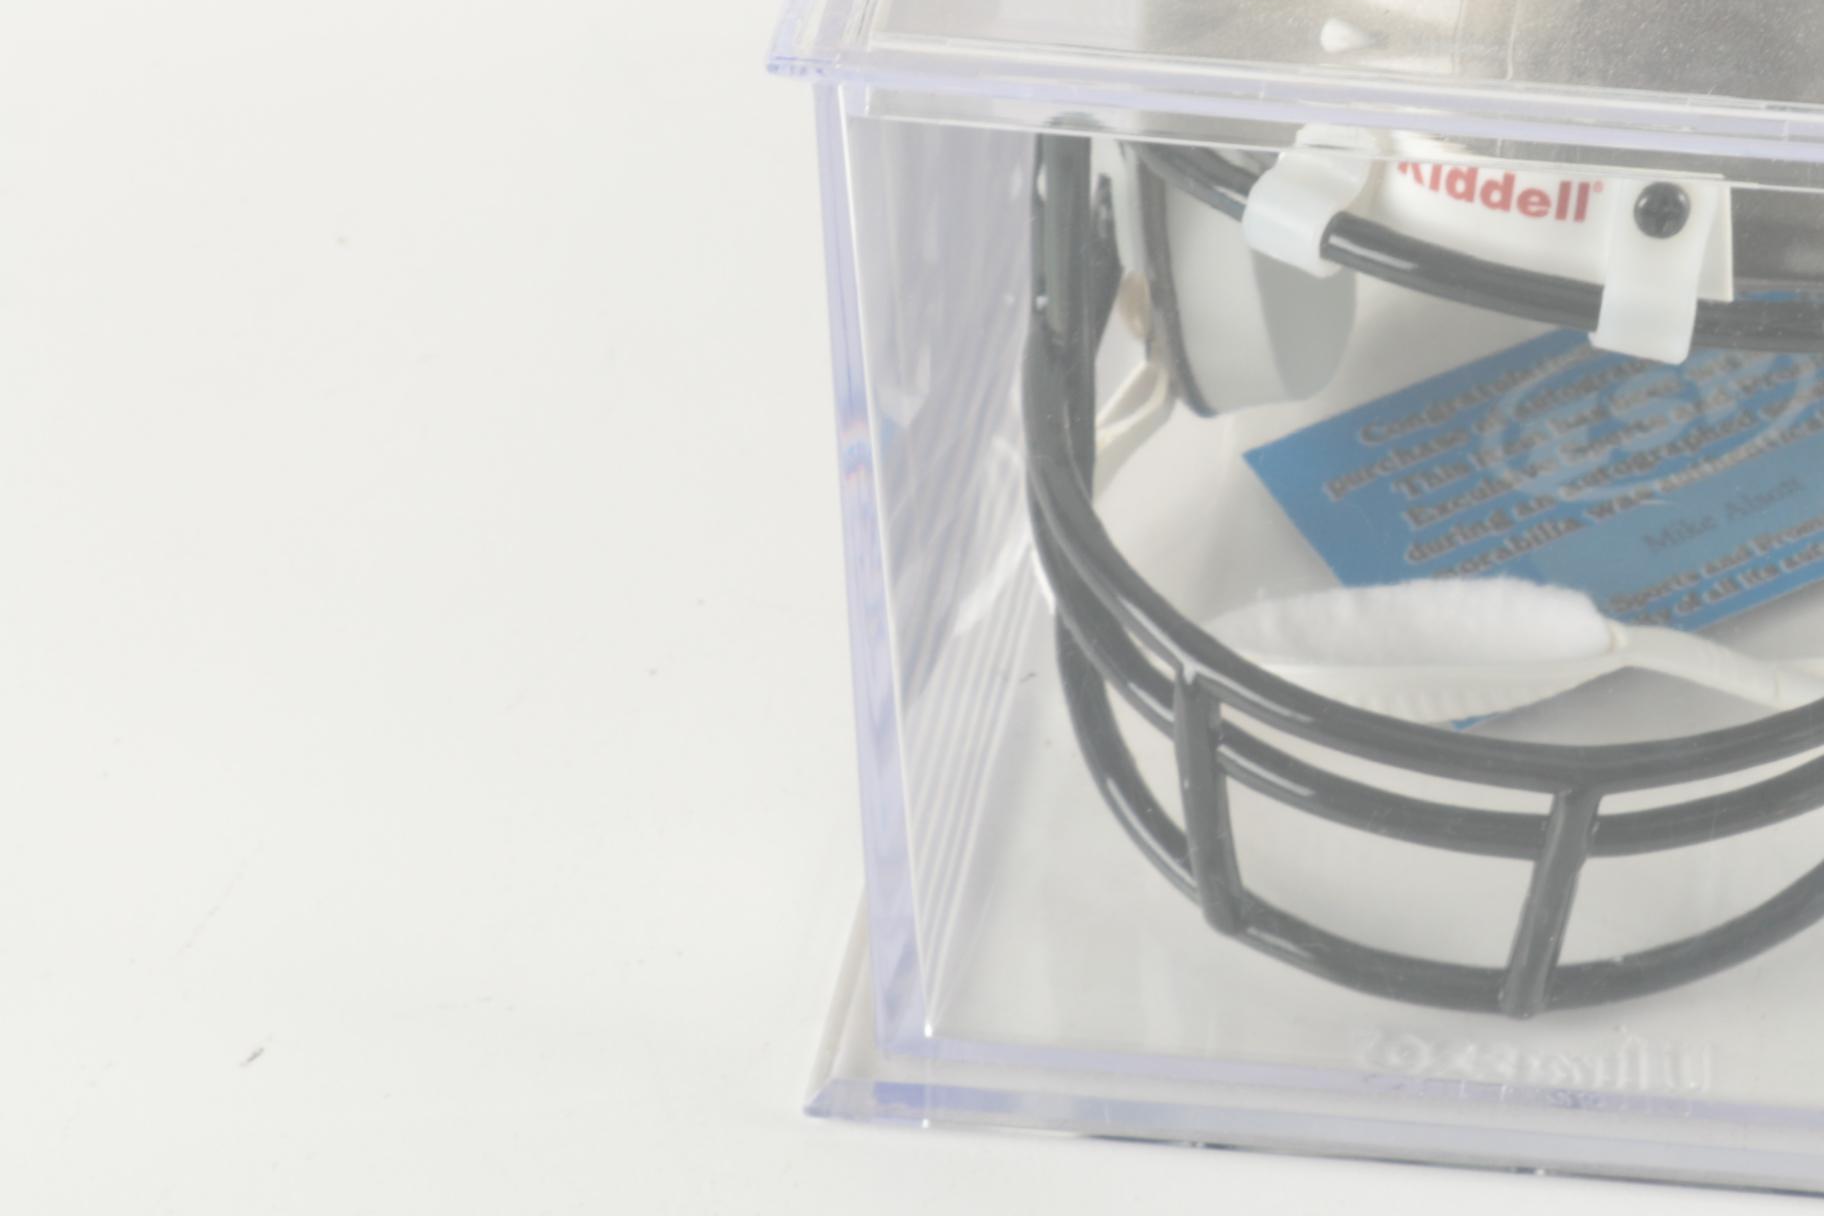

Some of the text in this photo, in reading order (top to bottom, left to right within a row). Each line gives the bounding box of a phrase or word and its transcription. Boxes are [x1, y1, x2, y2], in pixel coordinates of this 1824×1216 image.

[1323, 424, 1465, 500] purchase
[1392, 456, 1470, 502] This
[1587, 487, 1654, 521] was
[1403, 507, 1513, 565] during
[1513, 492, 1555, 518] an
[1643, 513, 1716, 555] Mike
[1700, 543, 1751, 576] and
[1673, 592, 1700, 614] of
[1702, 574, 1738, 602] all
[1739, 562, 1777, 587] its
